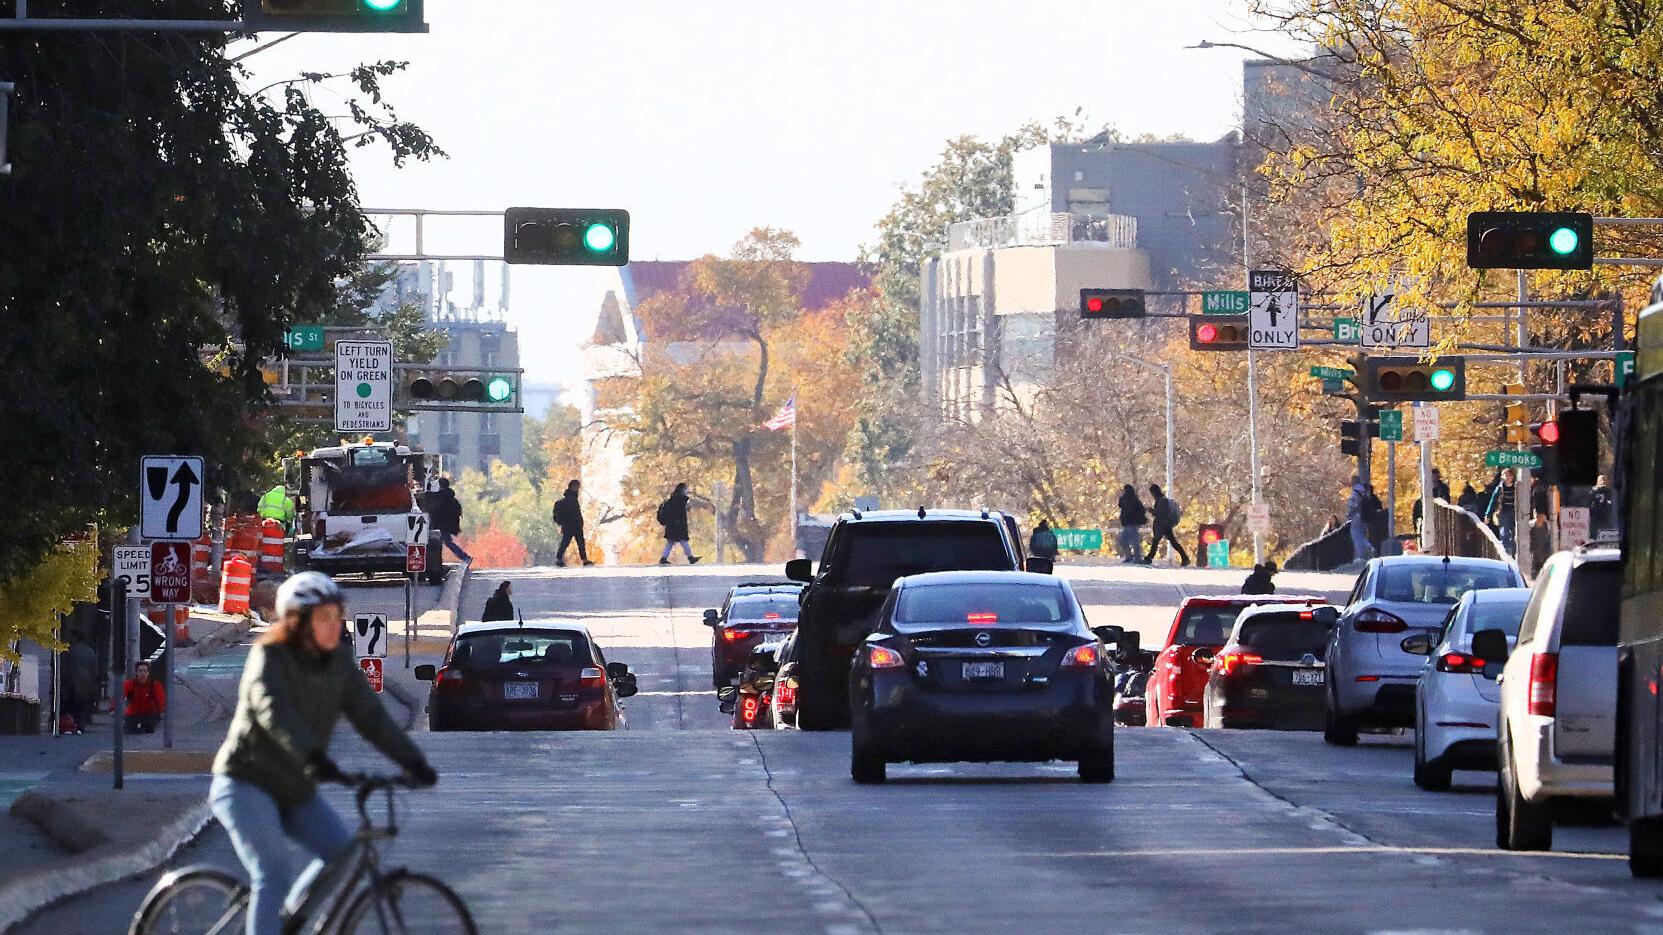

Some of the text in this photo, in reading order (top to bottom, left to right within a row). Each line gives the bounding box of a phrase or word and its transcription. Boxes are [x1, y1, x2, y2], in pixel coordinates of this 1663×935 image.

[1207, 294, 1245, 311] Mills
[1253, 330, 1294, 344] ONLY
[1372, 328, 1418, 344] ONY
[340, 346, 388, 356] LEFT TURN
[349, 358, 379, 369] YIELD
[341, 370, 387, 380] ON GREEN
[343, 401, 385, 410] TO BICYCLES
[342, 420, 385, 429] PEDESTRIANS
[1498, 453, 1537, 465] Brooks
[1568, 510, 1580, 520] NO
[116, 550, 151, 559] SPEED
[120, 561, 148, 570] LIMIT
[118, 574, 150, 594] 25
[154, 576, 188, 587] WRONG
[161, 588, 180, 598] WAY
